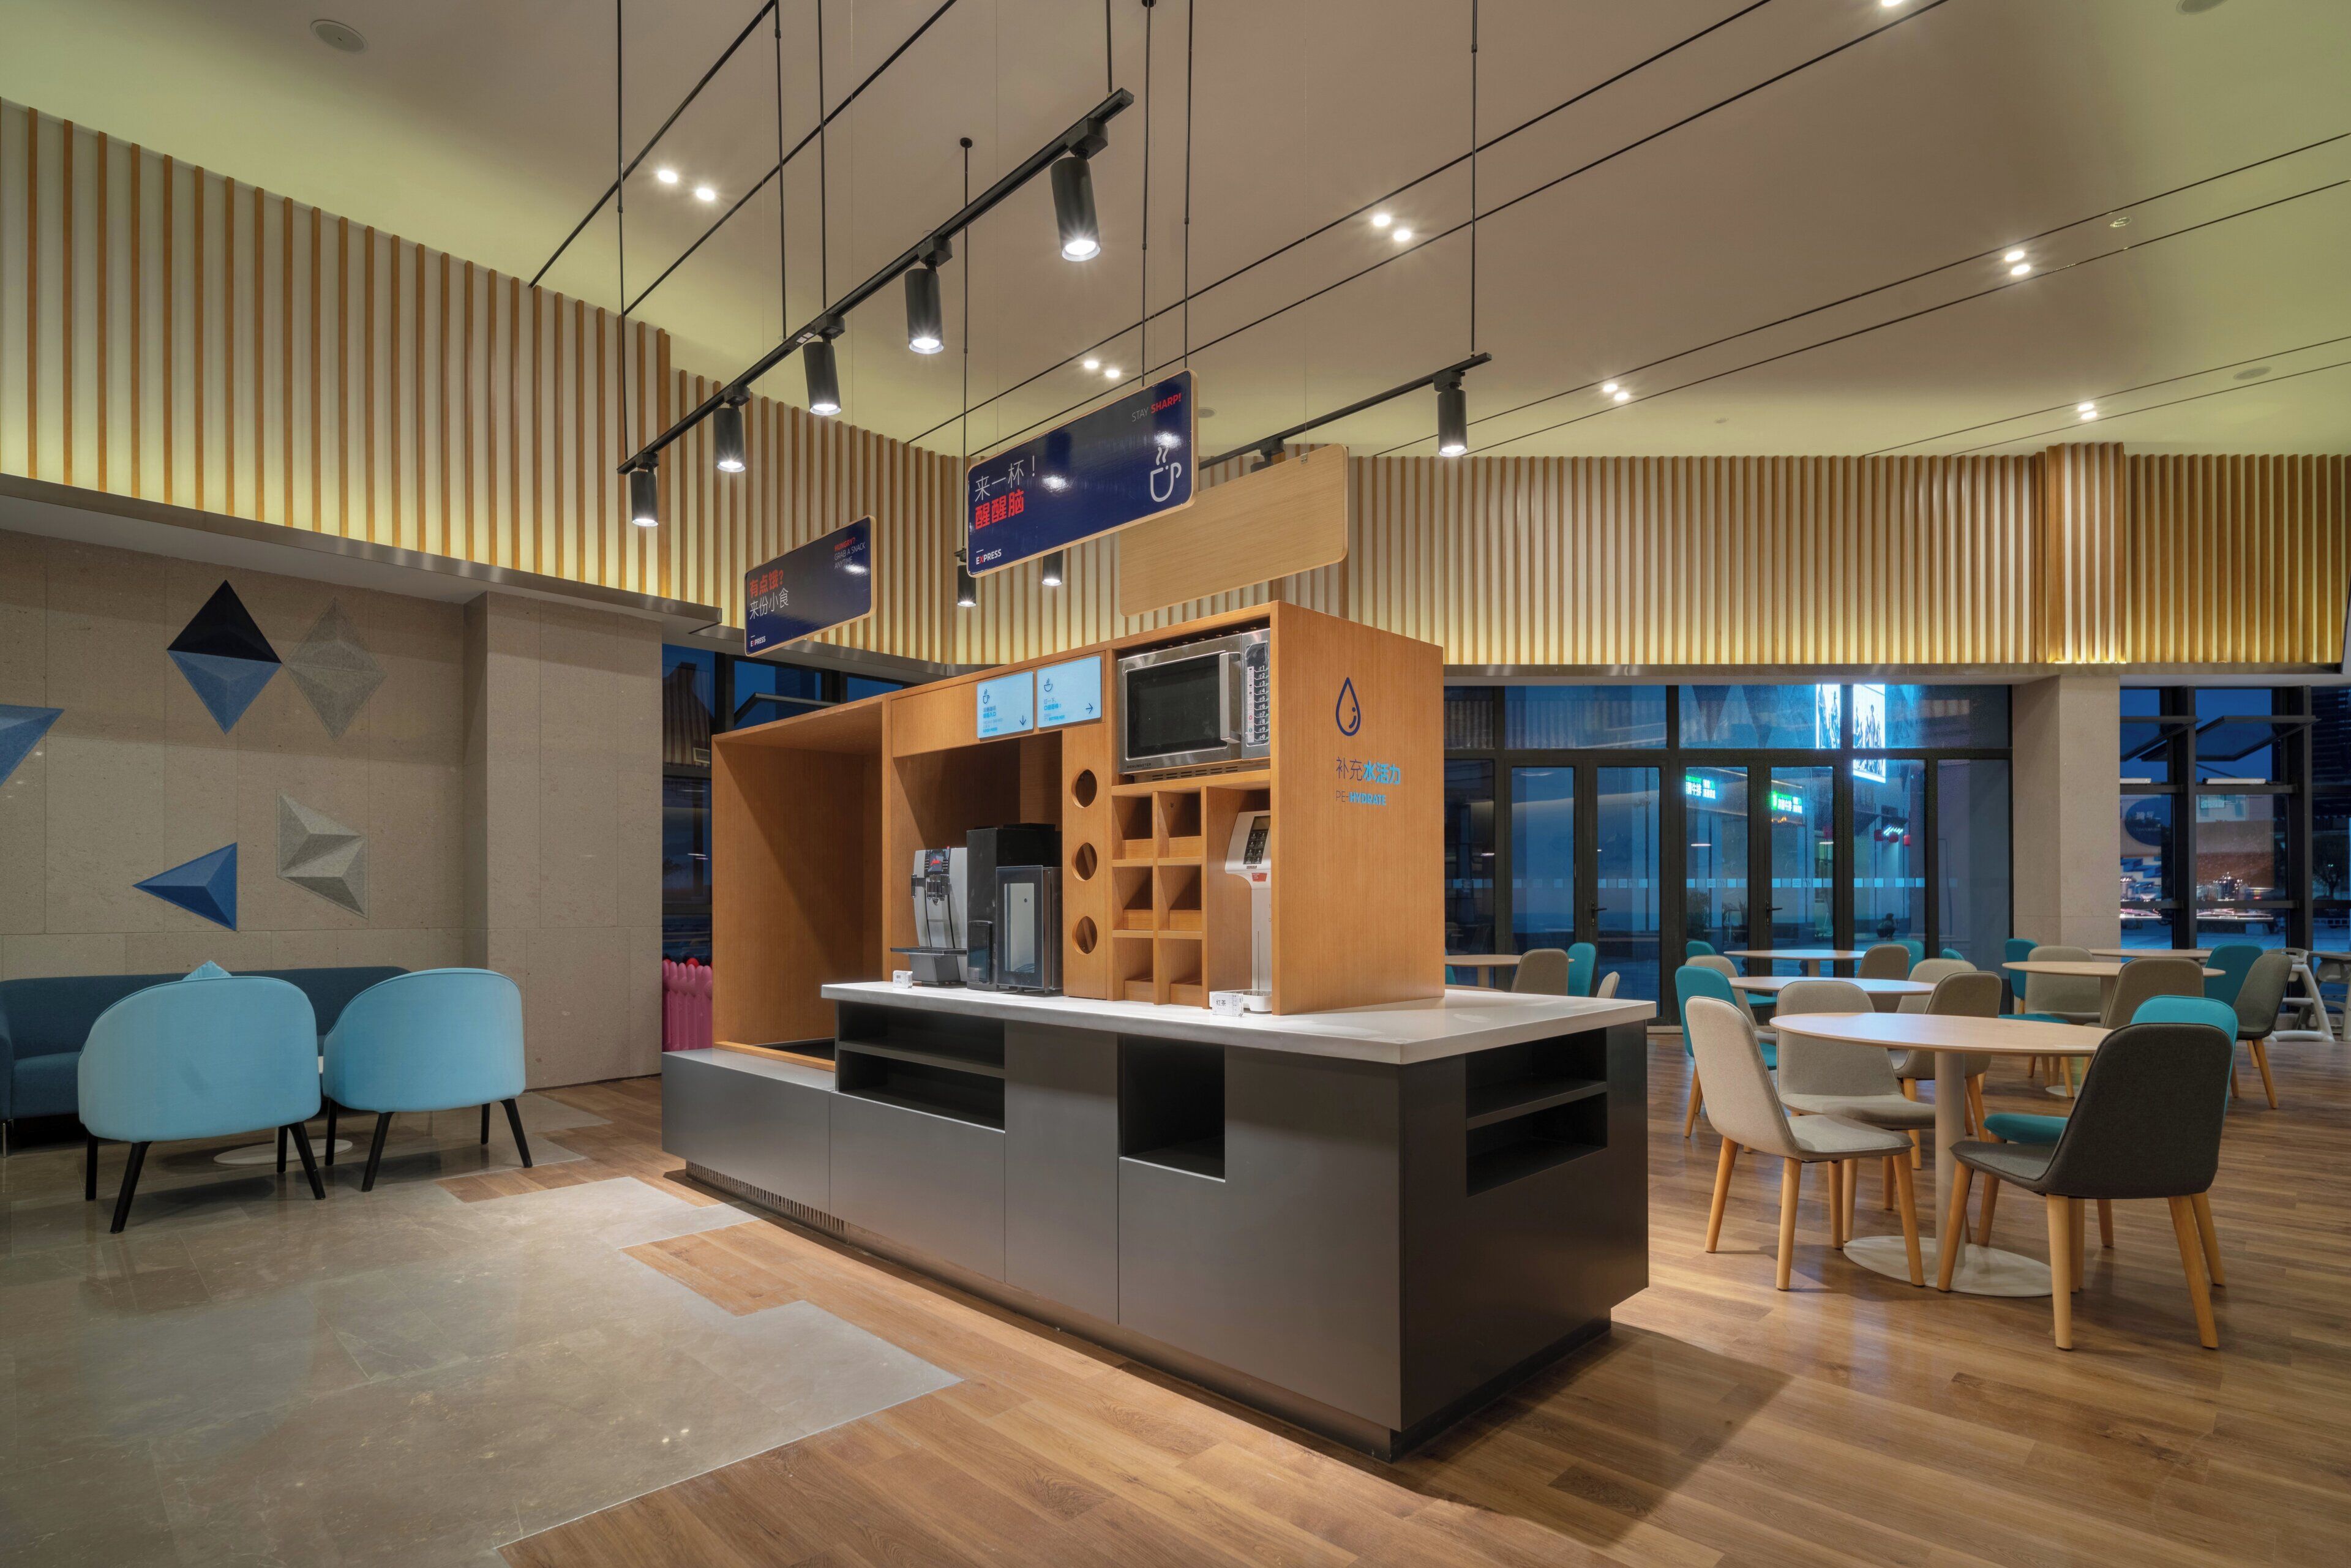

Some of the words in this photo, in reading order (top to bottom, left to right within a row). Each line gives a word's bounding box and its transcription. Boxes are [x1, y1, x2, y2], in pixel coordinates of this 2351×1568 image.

[1132, 407, 1149, 422] STAY
[1151, 392, 1182, 414] SHARP!
[975, 455, 1035, 502] 来一杯！
[975, 489, 1024, 530] 醒醒脑
[834, 537, 856, 551] HUNGRY?
[834, 550, 846, 560] GRAB
[852, 542, 866, 554] SNACK
[976, 549, 1002, 565] EXPRESS
[834, 556, 853, 569] ANYTIME
[750, 569, 784, 598] 有点饿？
[749, 587, 789, 620] 来份小食
[750, 636, 766, 647] EXPRESS
[1336, 757, 1401, 784] 补充水活力
